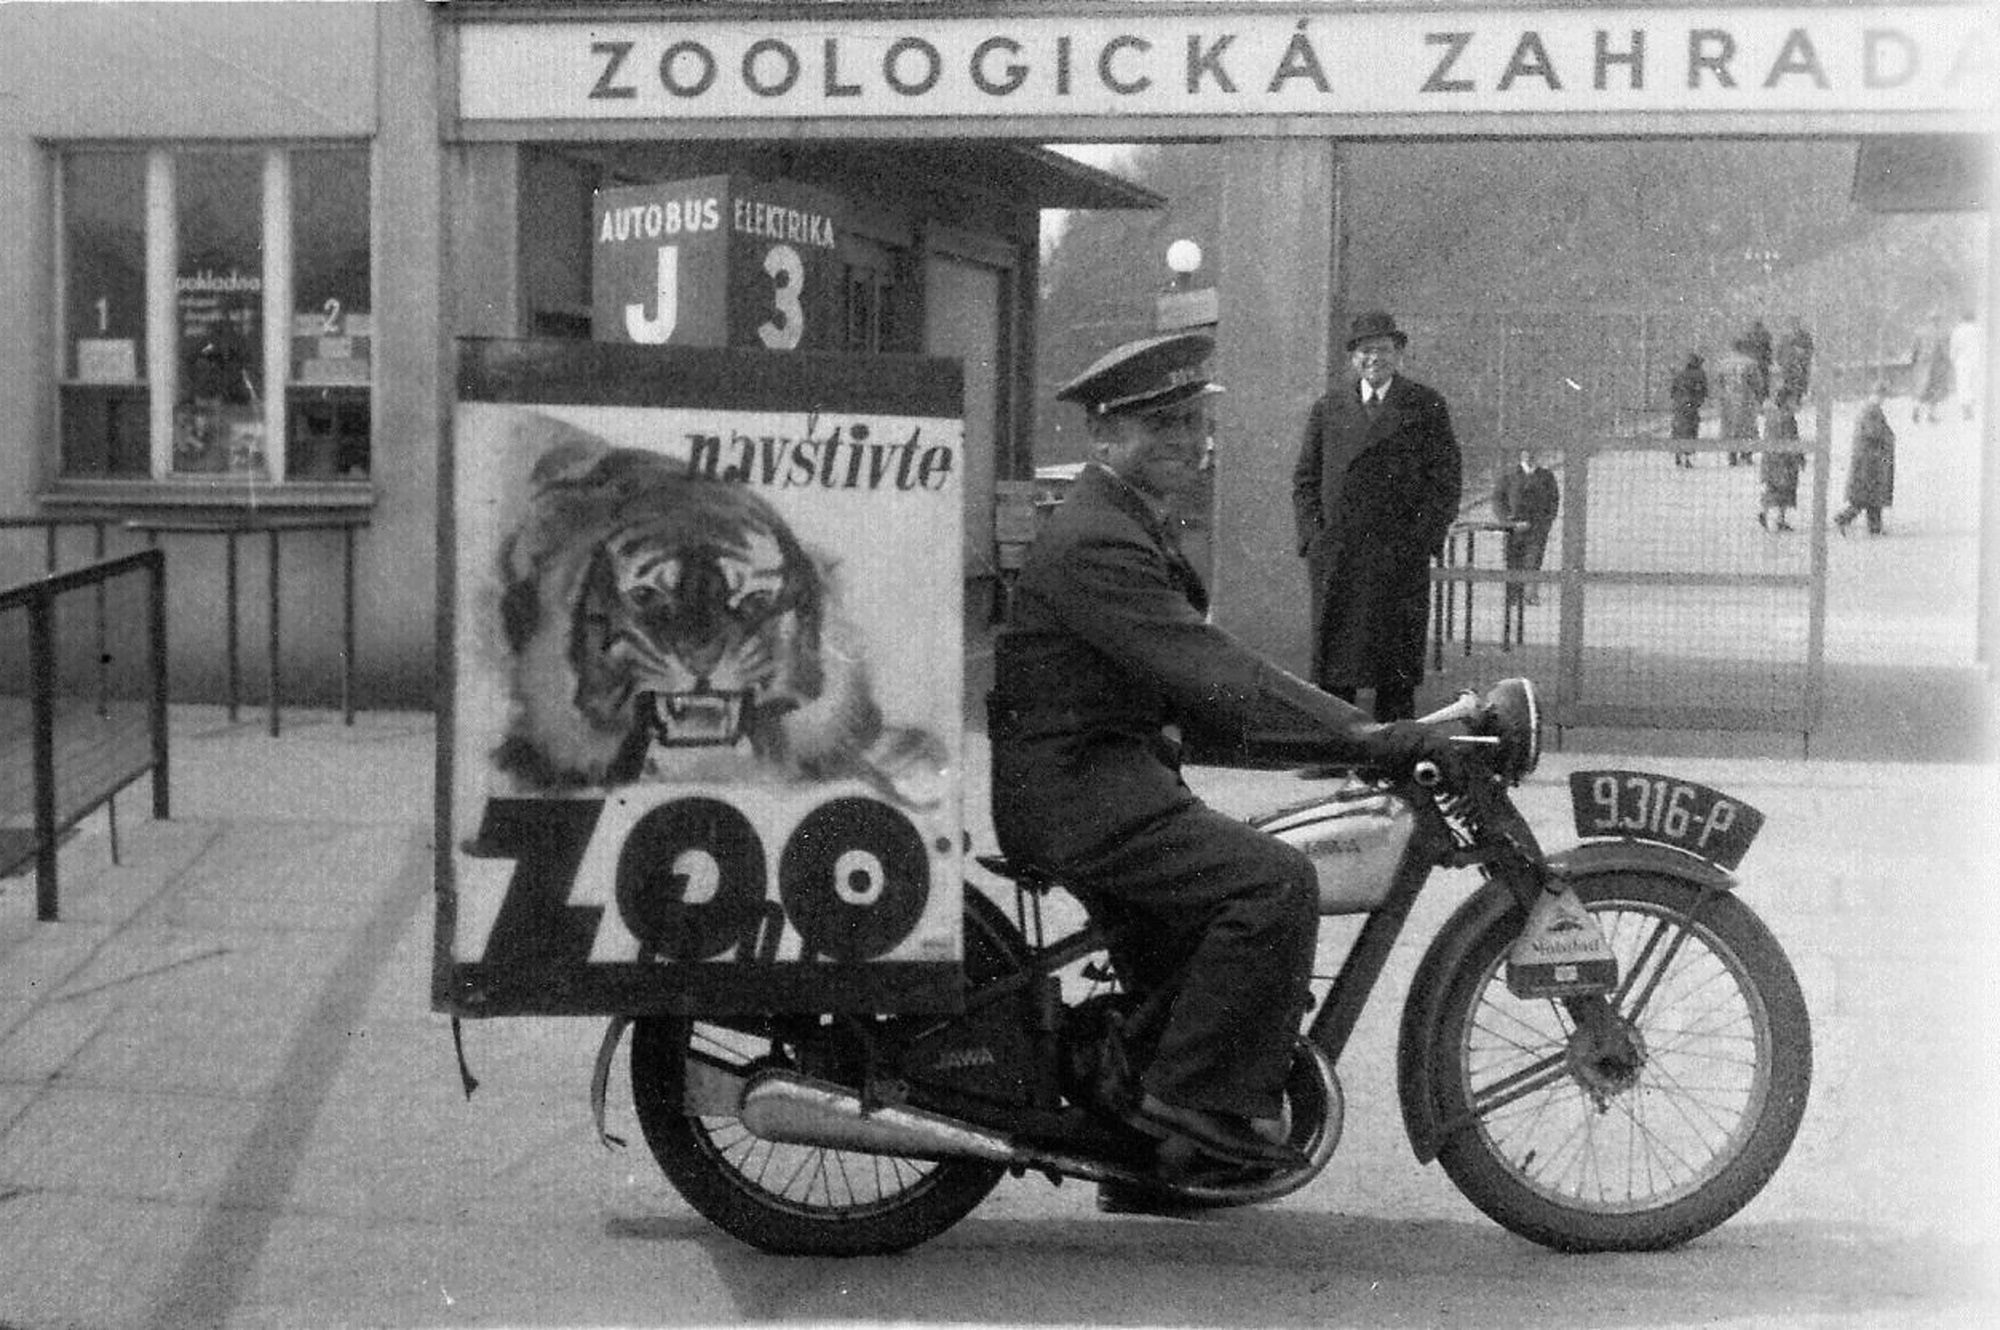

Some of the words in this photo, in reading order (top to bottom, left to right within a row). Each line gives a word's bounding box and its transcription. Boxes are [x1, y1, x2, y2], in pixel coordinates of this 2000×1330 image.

[588, 18, 1334, 99] ZOOLOGICKÁ
[601, 198, 719, 242] AUTOBUS
[735, 198, 834, 249] ELEKTRIKA
[96, 298, 106, 330] 1
[323, 298, 339, 332] 2
[626, 246, 678, 344] J
[758, 245, 803, 349] 3
[468, 797, 930, 963] ZOO
[933, 1048, 994, 1069] JAWA
